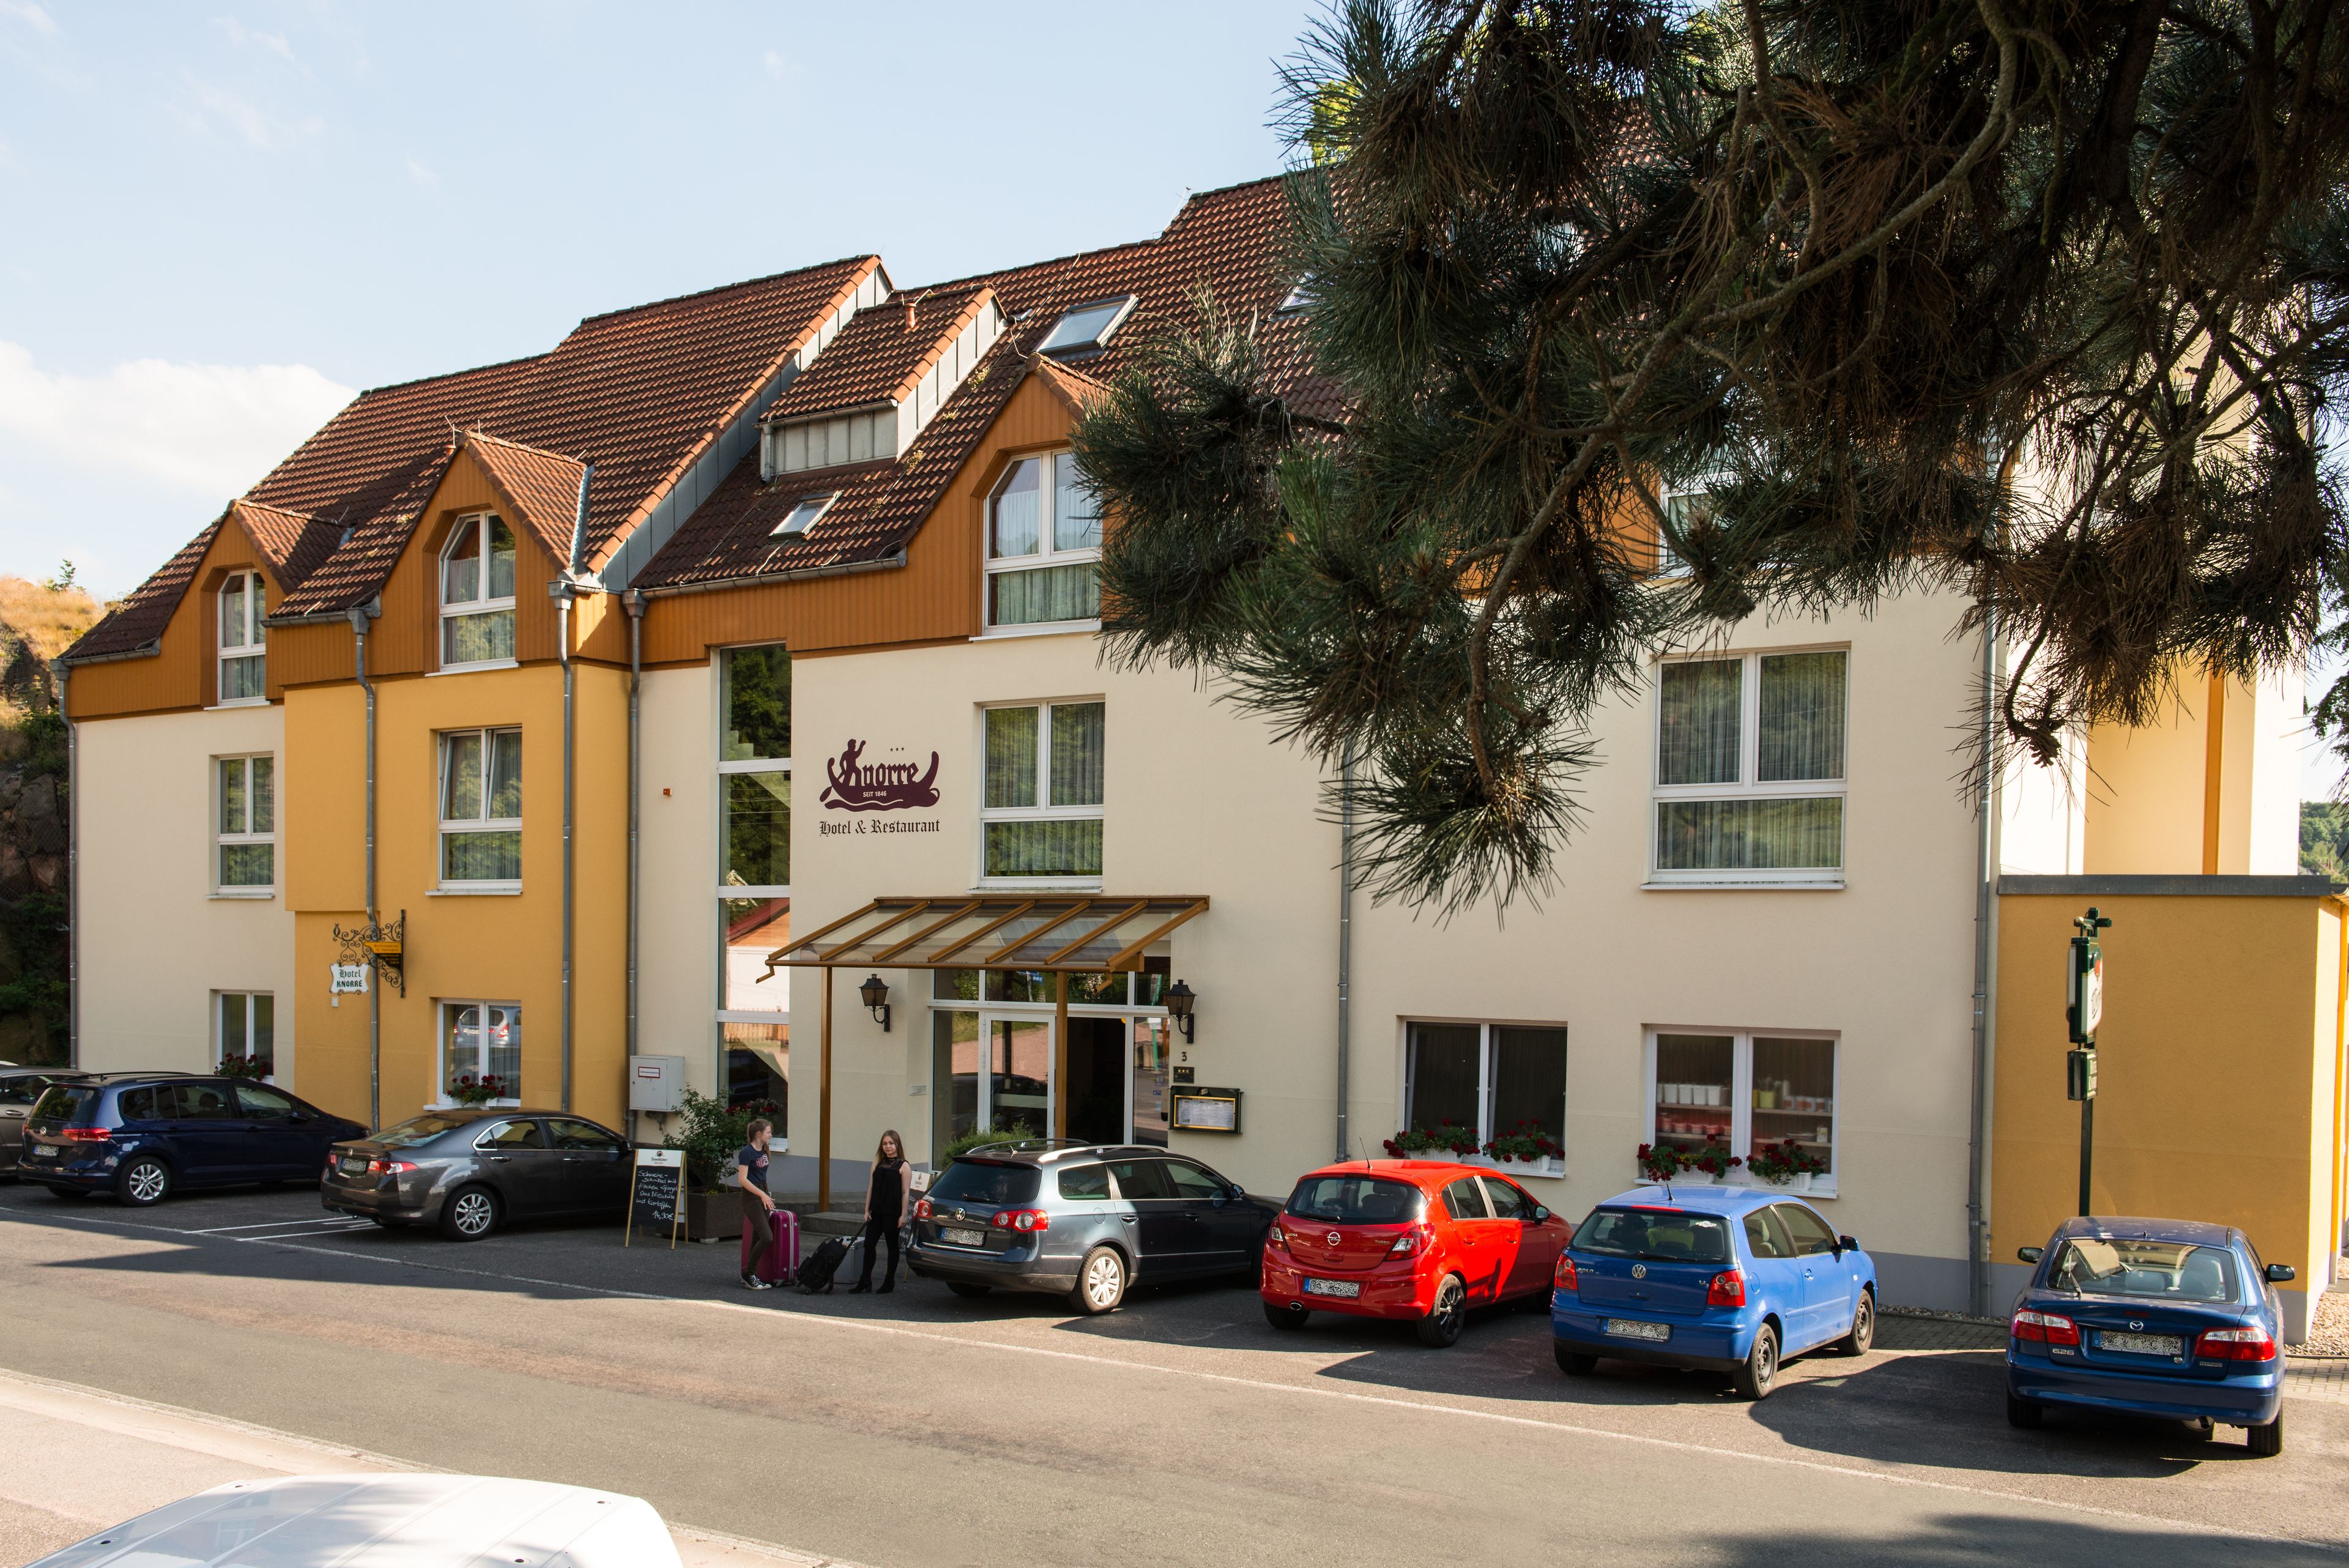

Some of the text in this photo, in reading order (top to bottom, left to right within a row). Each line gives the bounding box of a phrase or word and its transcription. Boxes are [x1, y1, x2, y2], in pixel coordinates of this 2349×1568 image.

[819, 819, 940, 837] Hotel & Restaurant
[339, 969, 361, 978] Hotel
[1181, 1052, 1187, 1061] 3
